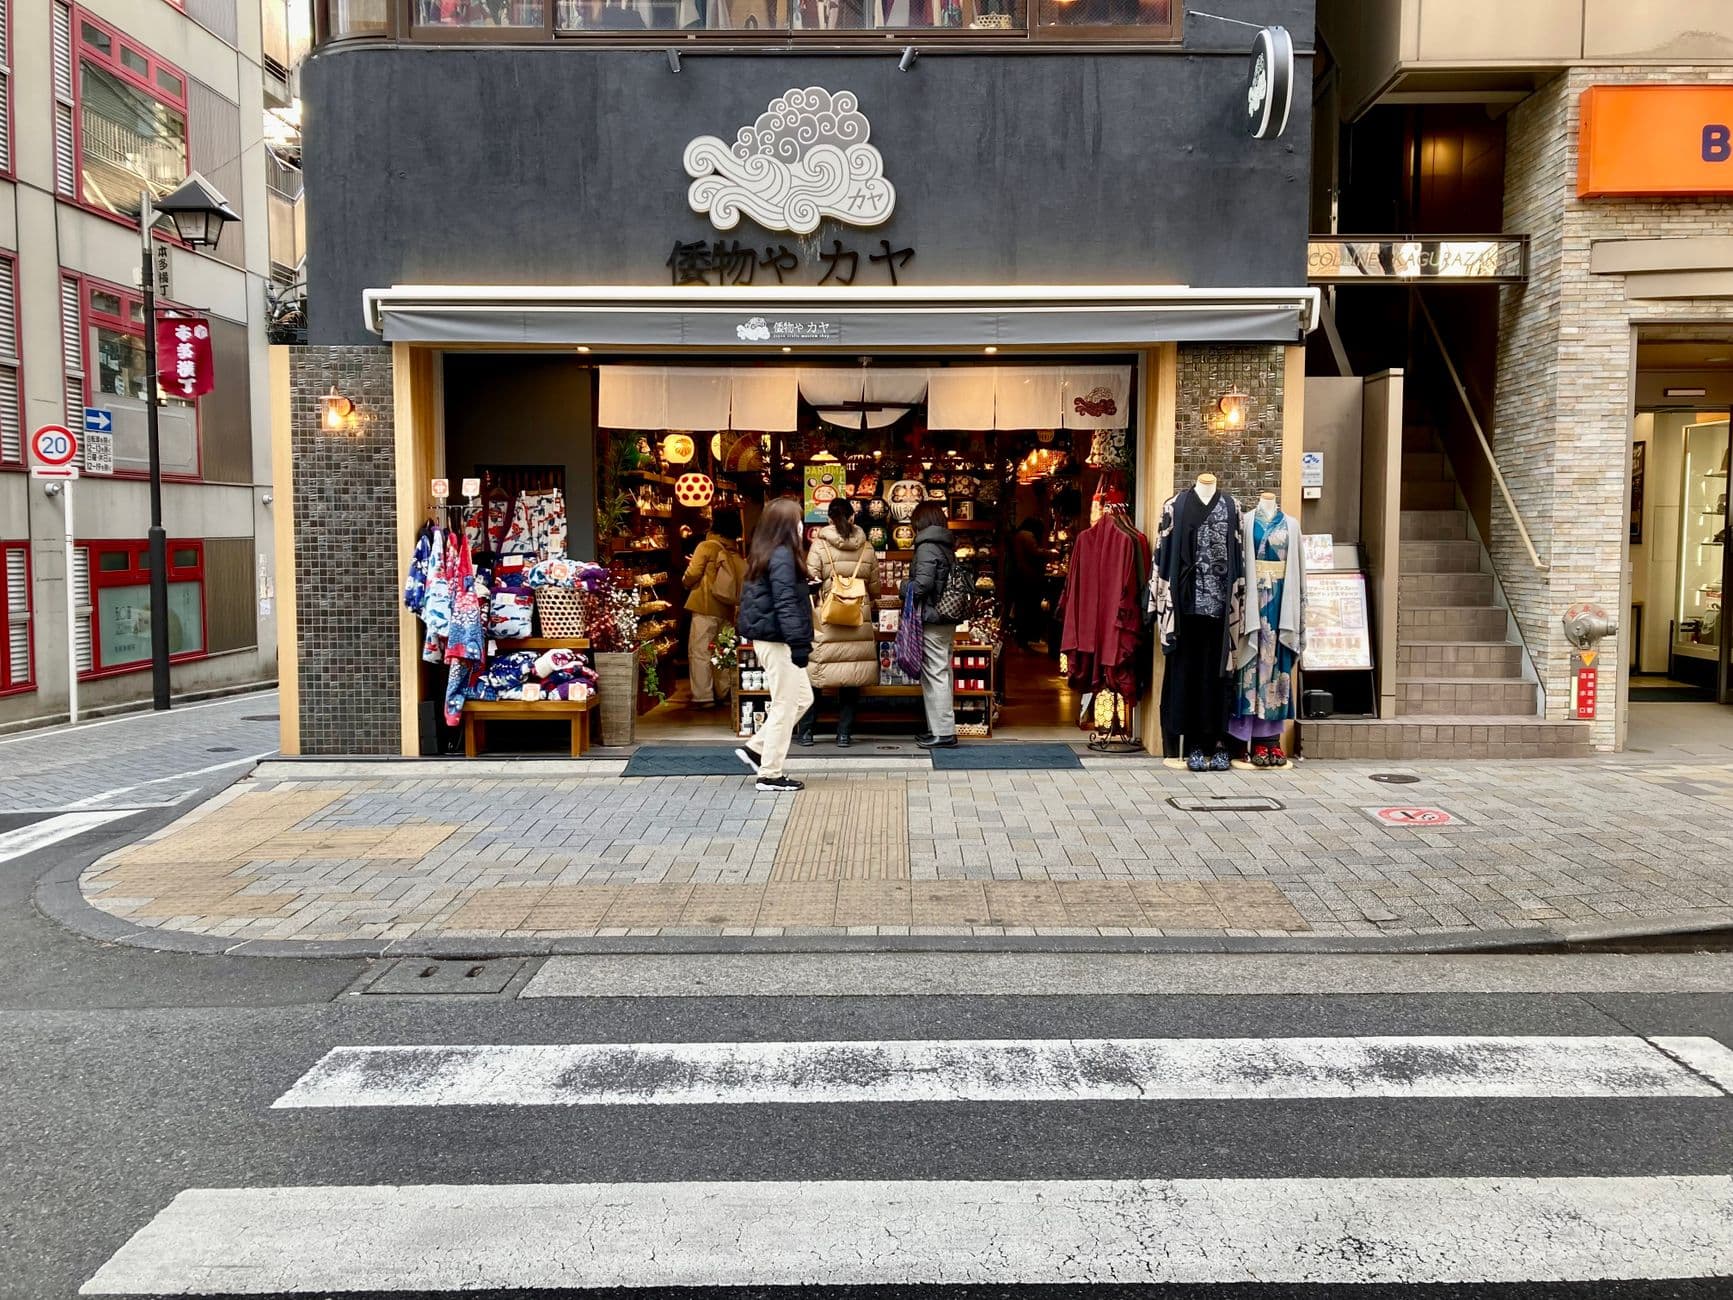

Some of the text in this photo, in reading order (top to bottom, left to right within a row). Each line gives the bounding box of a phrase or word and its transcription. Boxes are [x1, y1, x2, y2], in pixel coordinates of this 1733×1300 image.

[847, 188, 884, 211] カヤ
[818, 240, 915, 286] カヤ
[1309, 252, 1377, 266] COLLINE
[158, 246, 169, 296] 本多横丁
[806, 321, 830, 334] カヤ
[42, 437, 67, 454] 20
